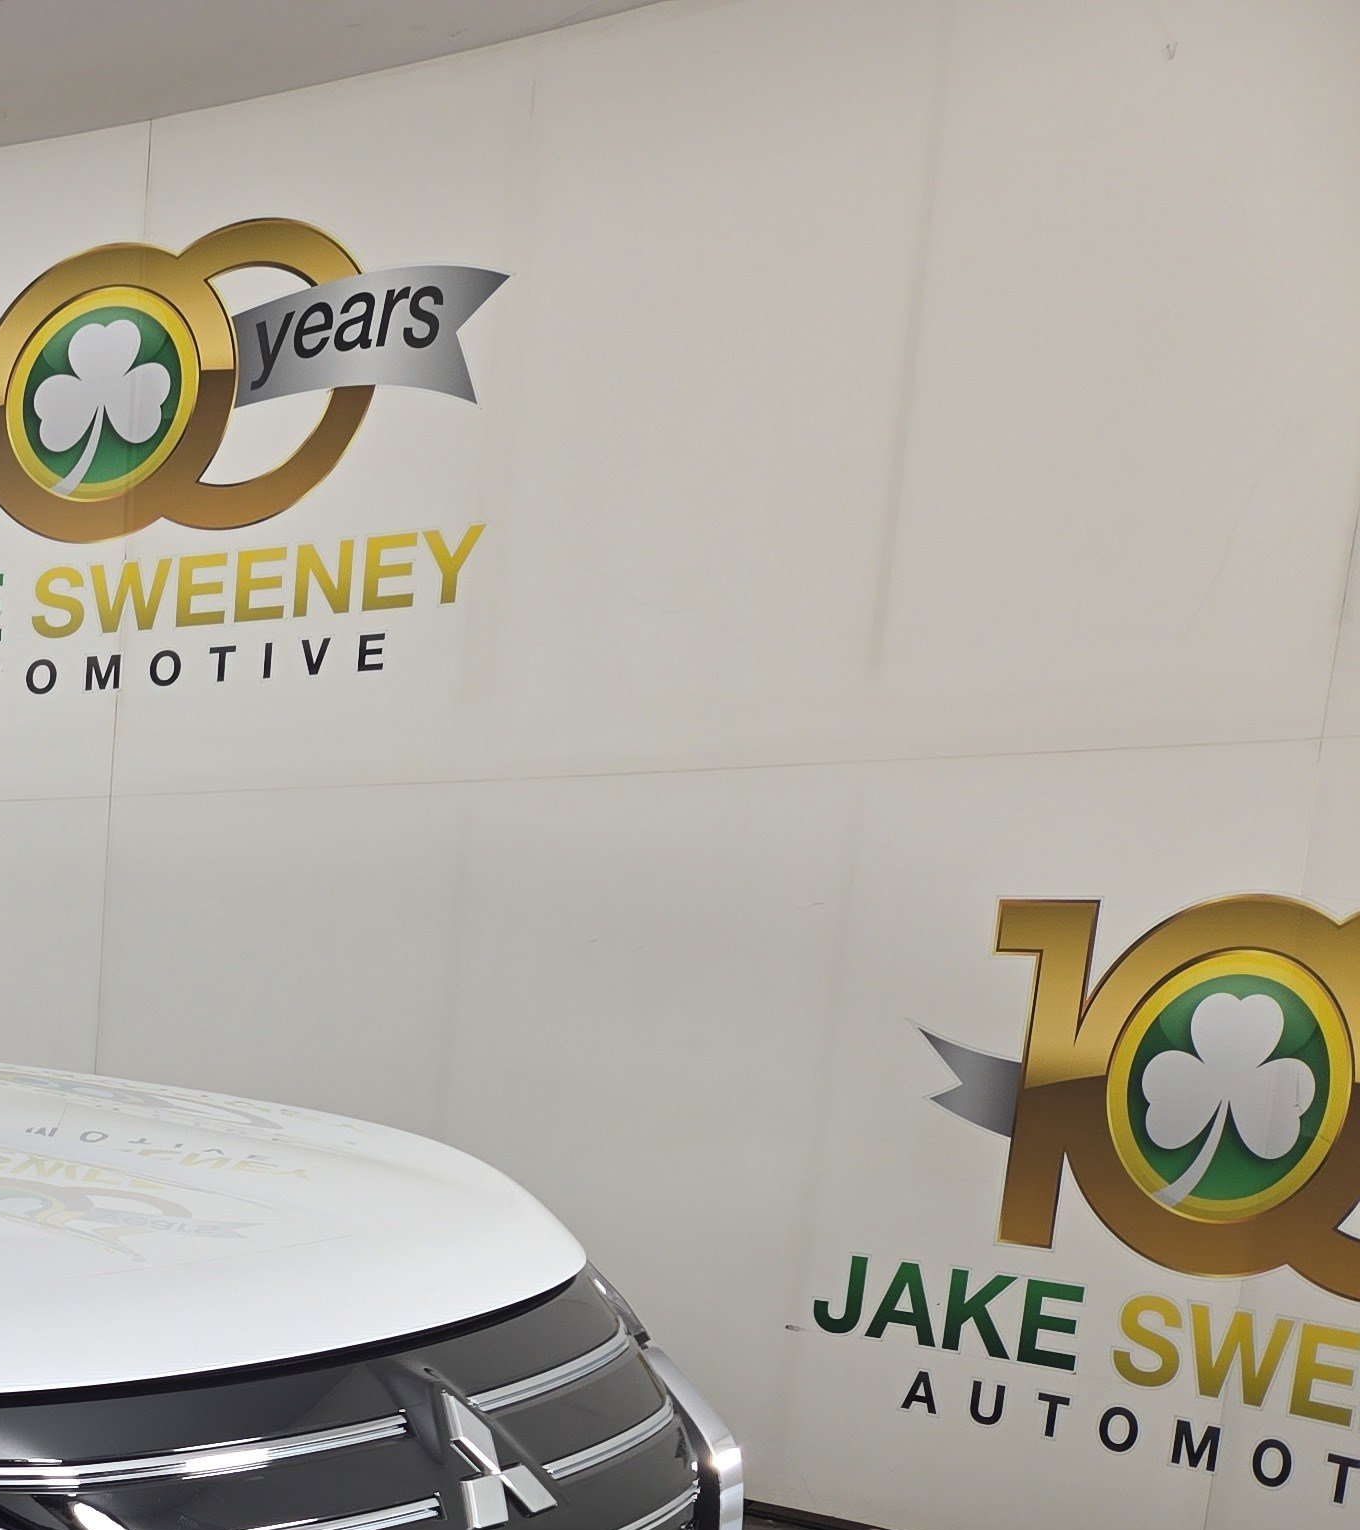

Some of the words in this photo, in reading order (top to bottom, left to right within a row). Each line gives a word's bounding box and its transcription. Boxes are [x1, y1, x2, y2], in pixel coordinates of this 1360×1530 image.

[250, 285, 444, 391] years
[30, 524, 487, 639] SWEENEY
[813, 1254, 1085, 1372] JAKE
